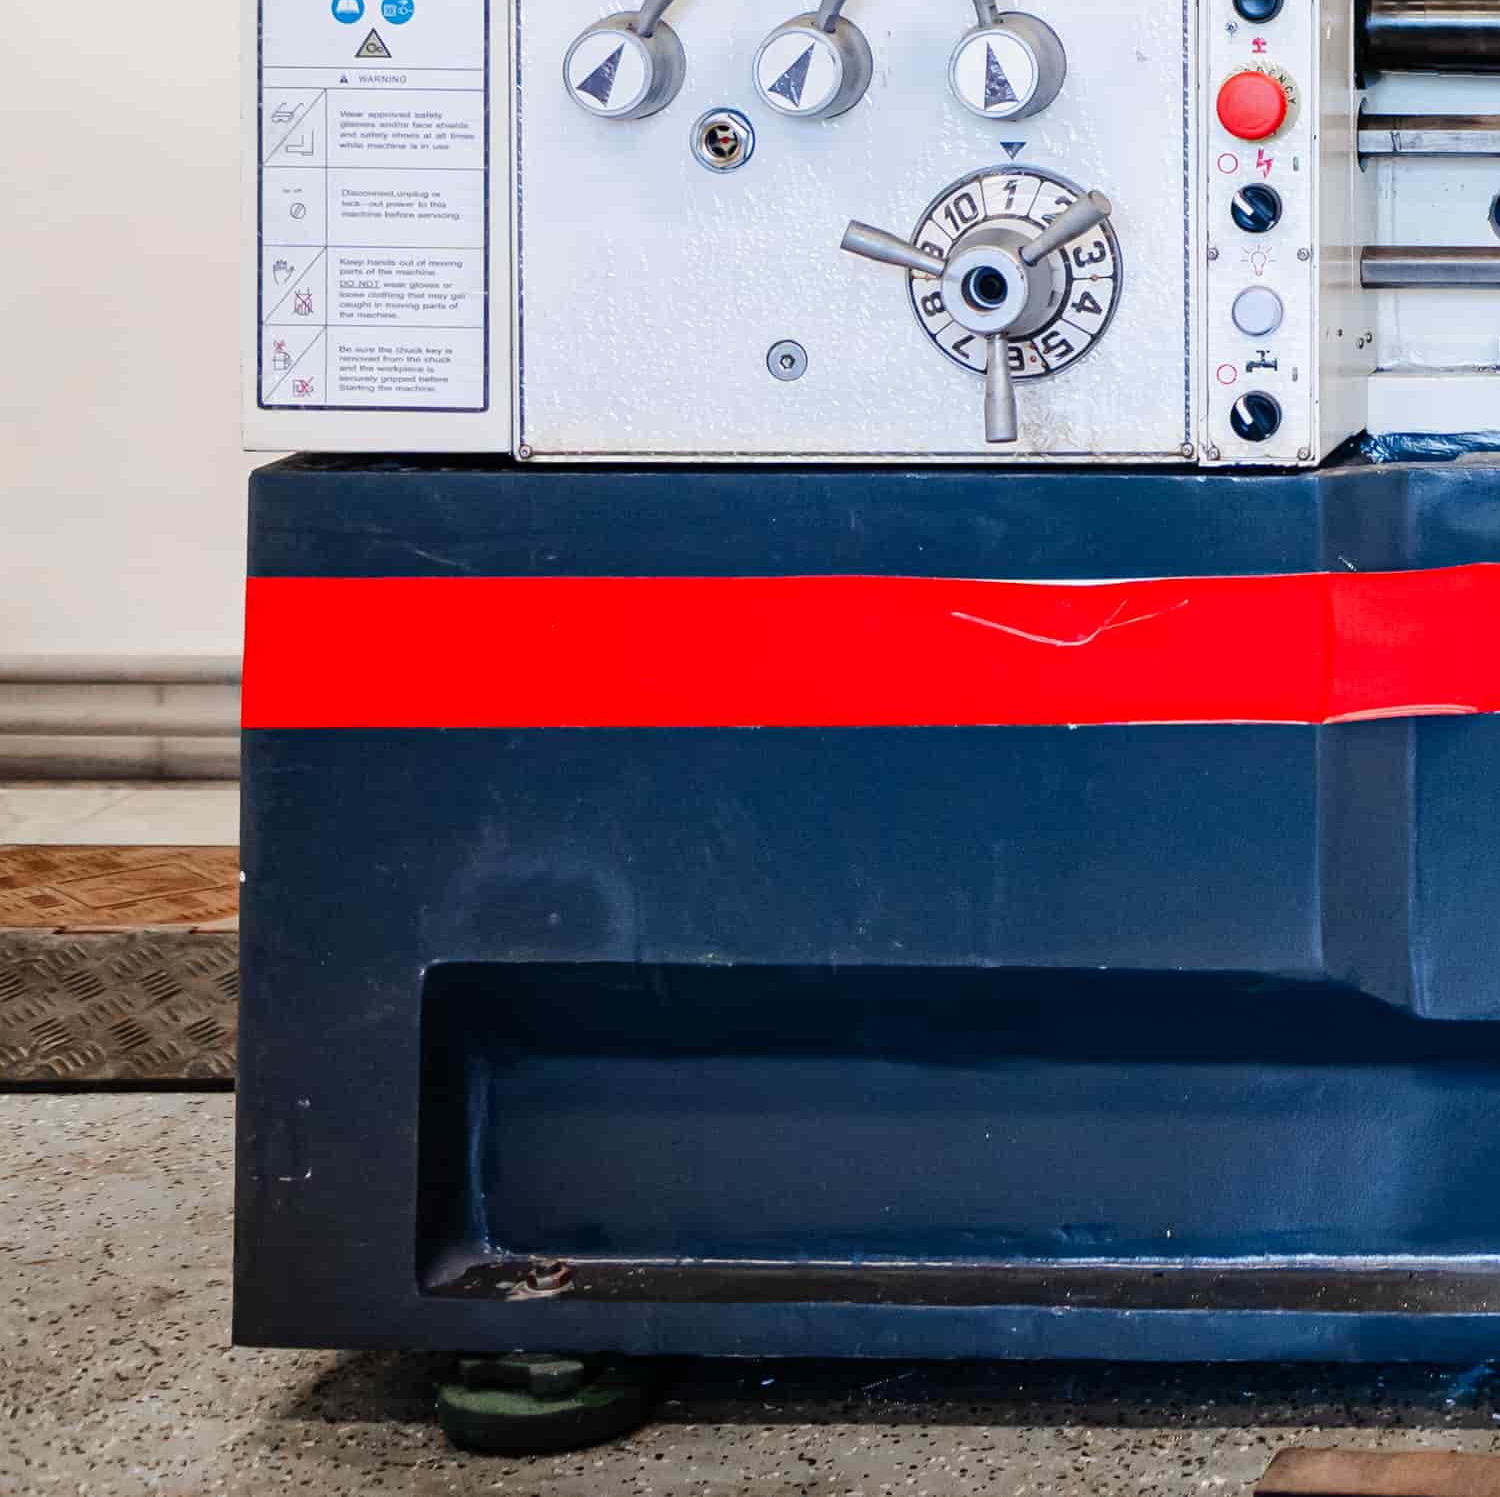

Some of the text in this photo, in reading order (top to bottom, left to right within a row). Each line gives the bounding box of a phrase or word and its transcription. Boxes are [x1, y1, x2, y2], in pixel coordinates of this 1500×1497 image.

[358, 75, 407, 84] WARNING
[1003, 180, 1018, 210] 1
[944, 192, 980, 232] 10
[1073, 241, 1106, 268] 3
[1072, 291, 1103, 315] 4
[952, 334, 976, 359] 7
[1041, 330, 1074, 360] 5
